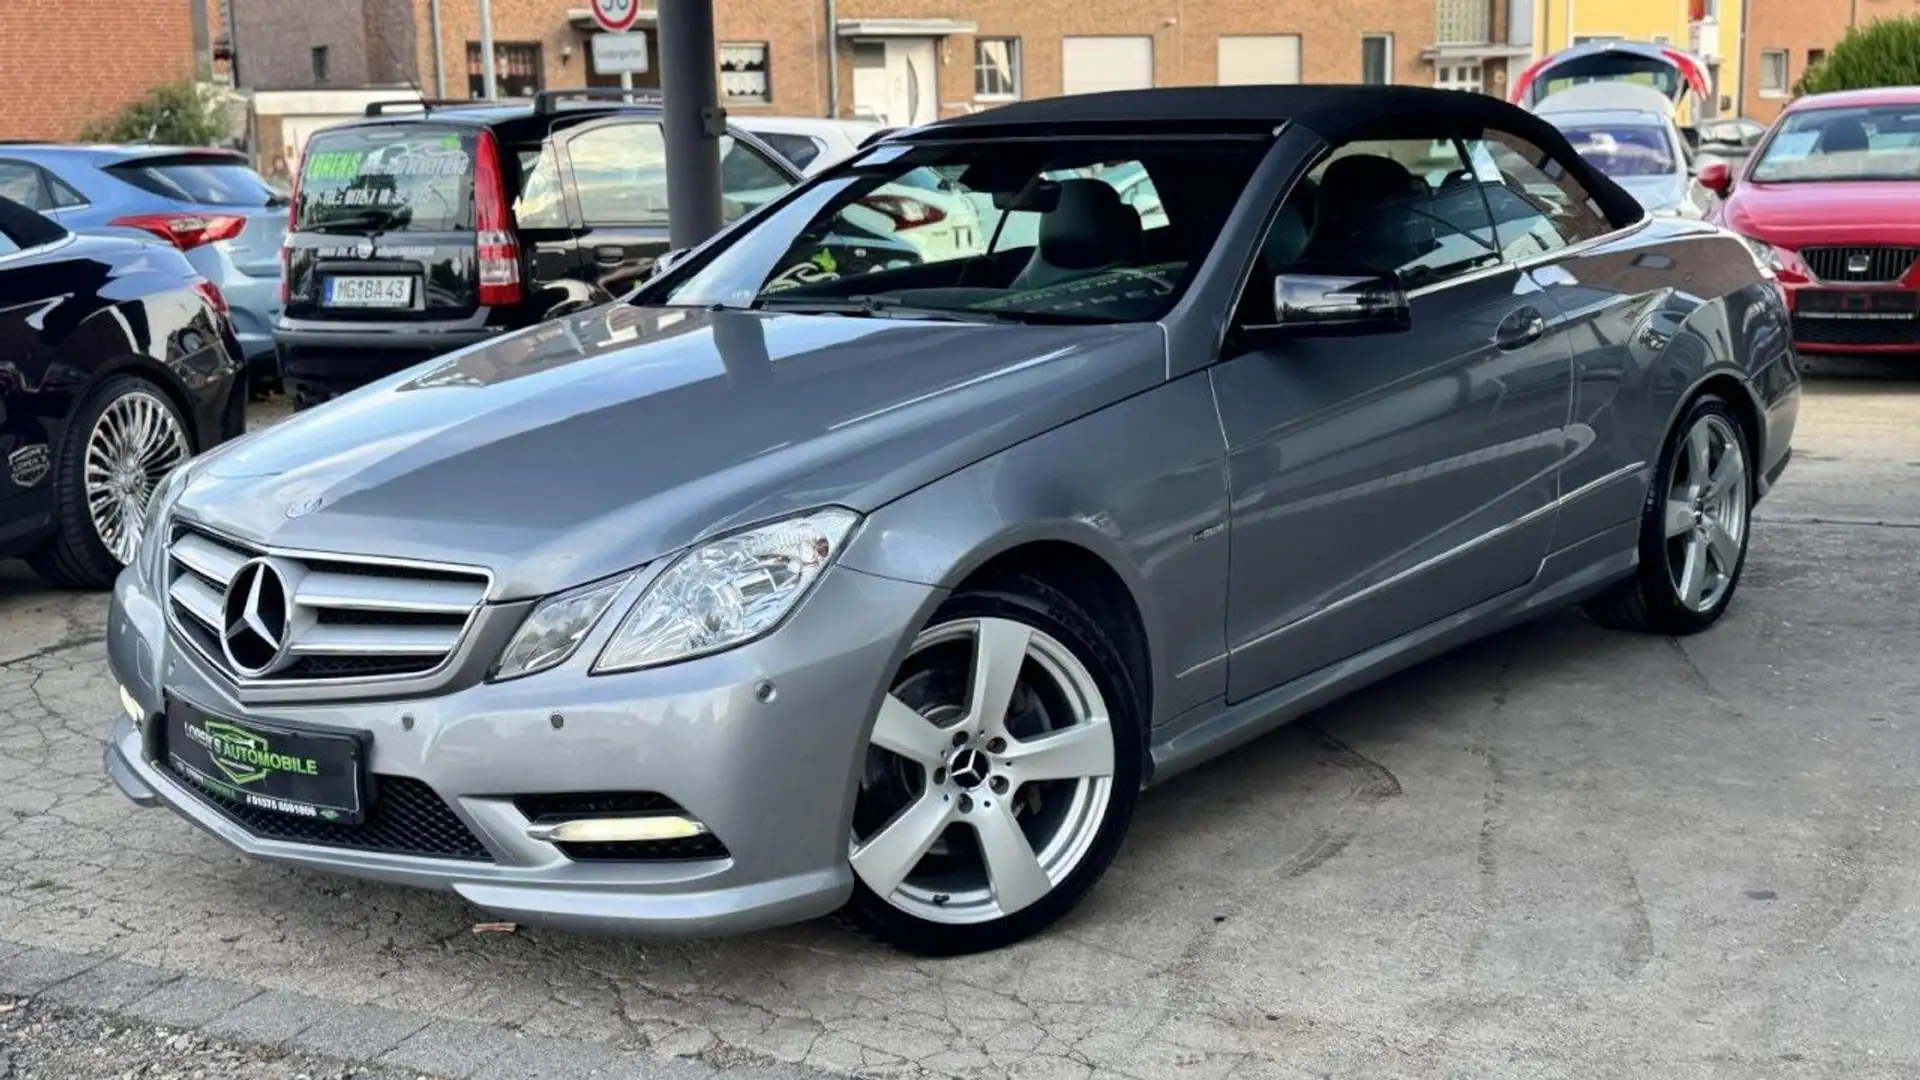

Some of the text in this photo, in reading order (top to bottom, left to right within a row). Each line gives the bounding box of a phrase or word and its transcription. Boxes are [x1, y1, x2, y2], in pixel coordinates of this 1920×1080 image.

[364, 280, 382, 299] BA
[386, 280, 405, 299] 43
[223, 742, 319, 776] AUTOMOBILE
